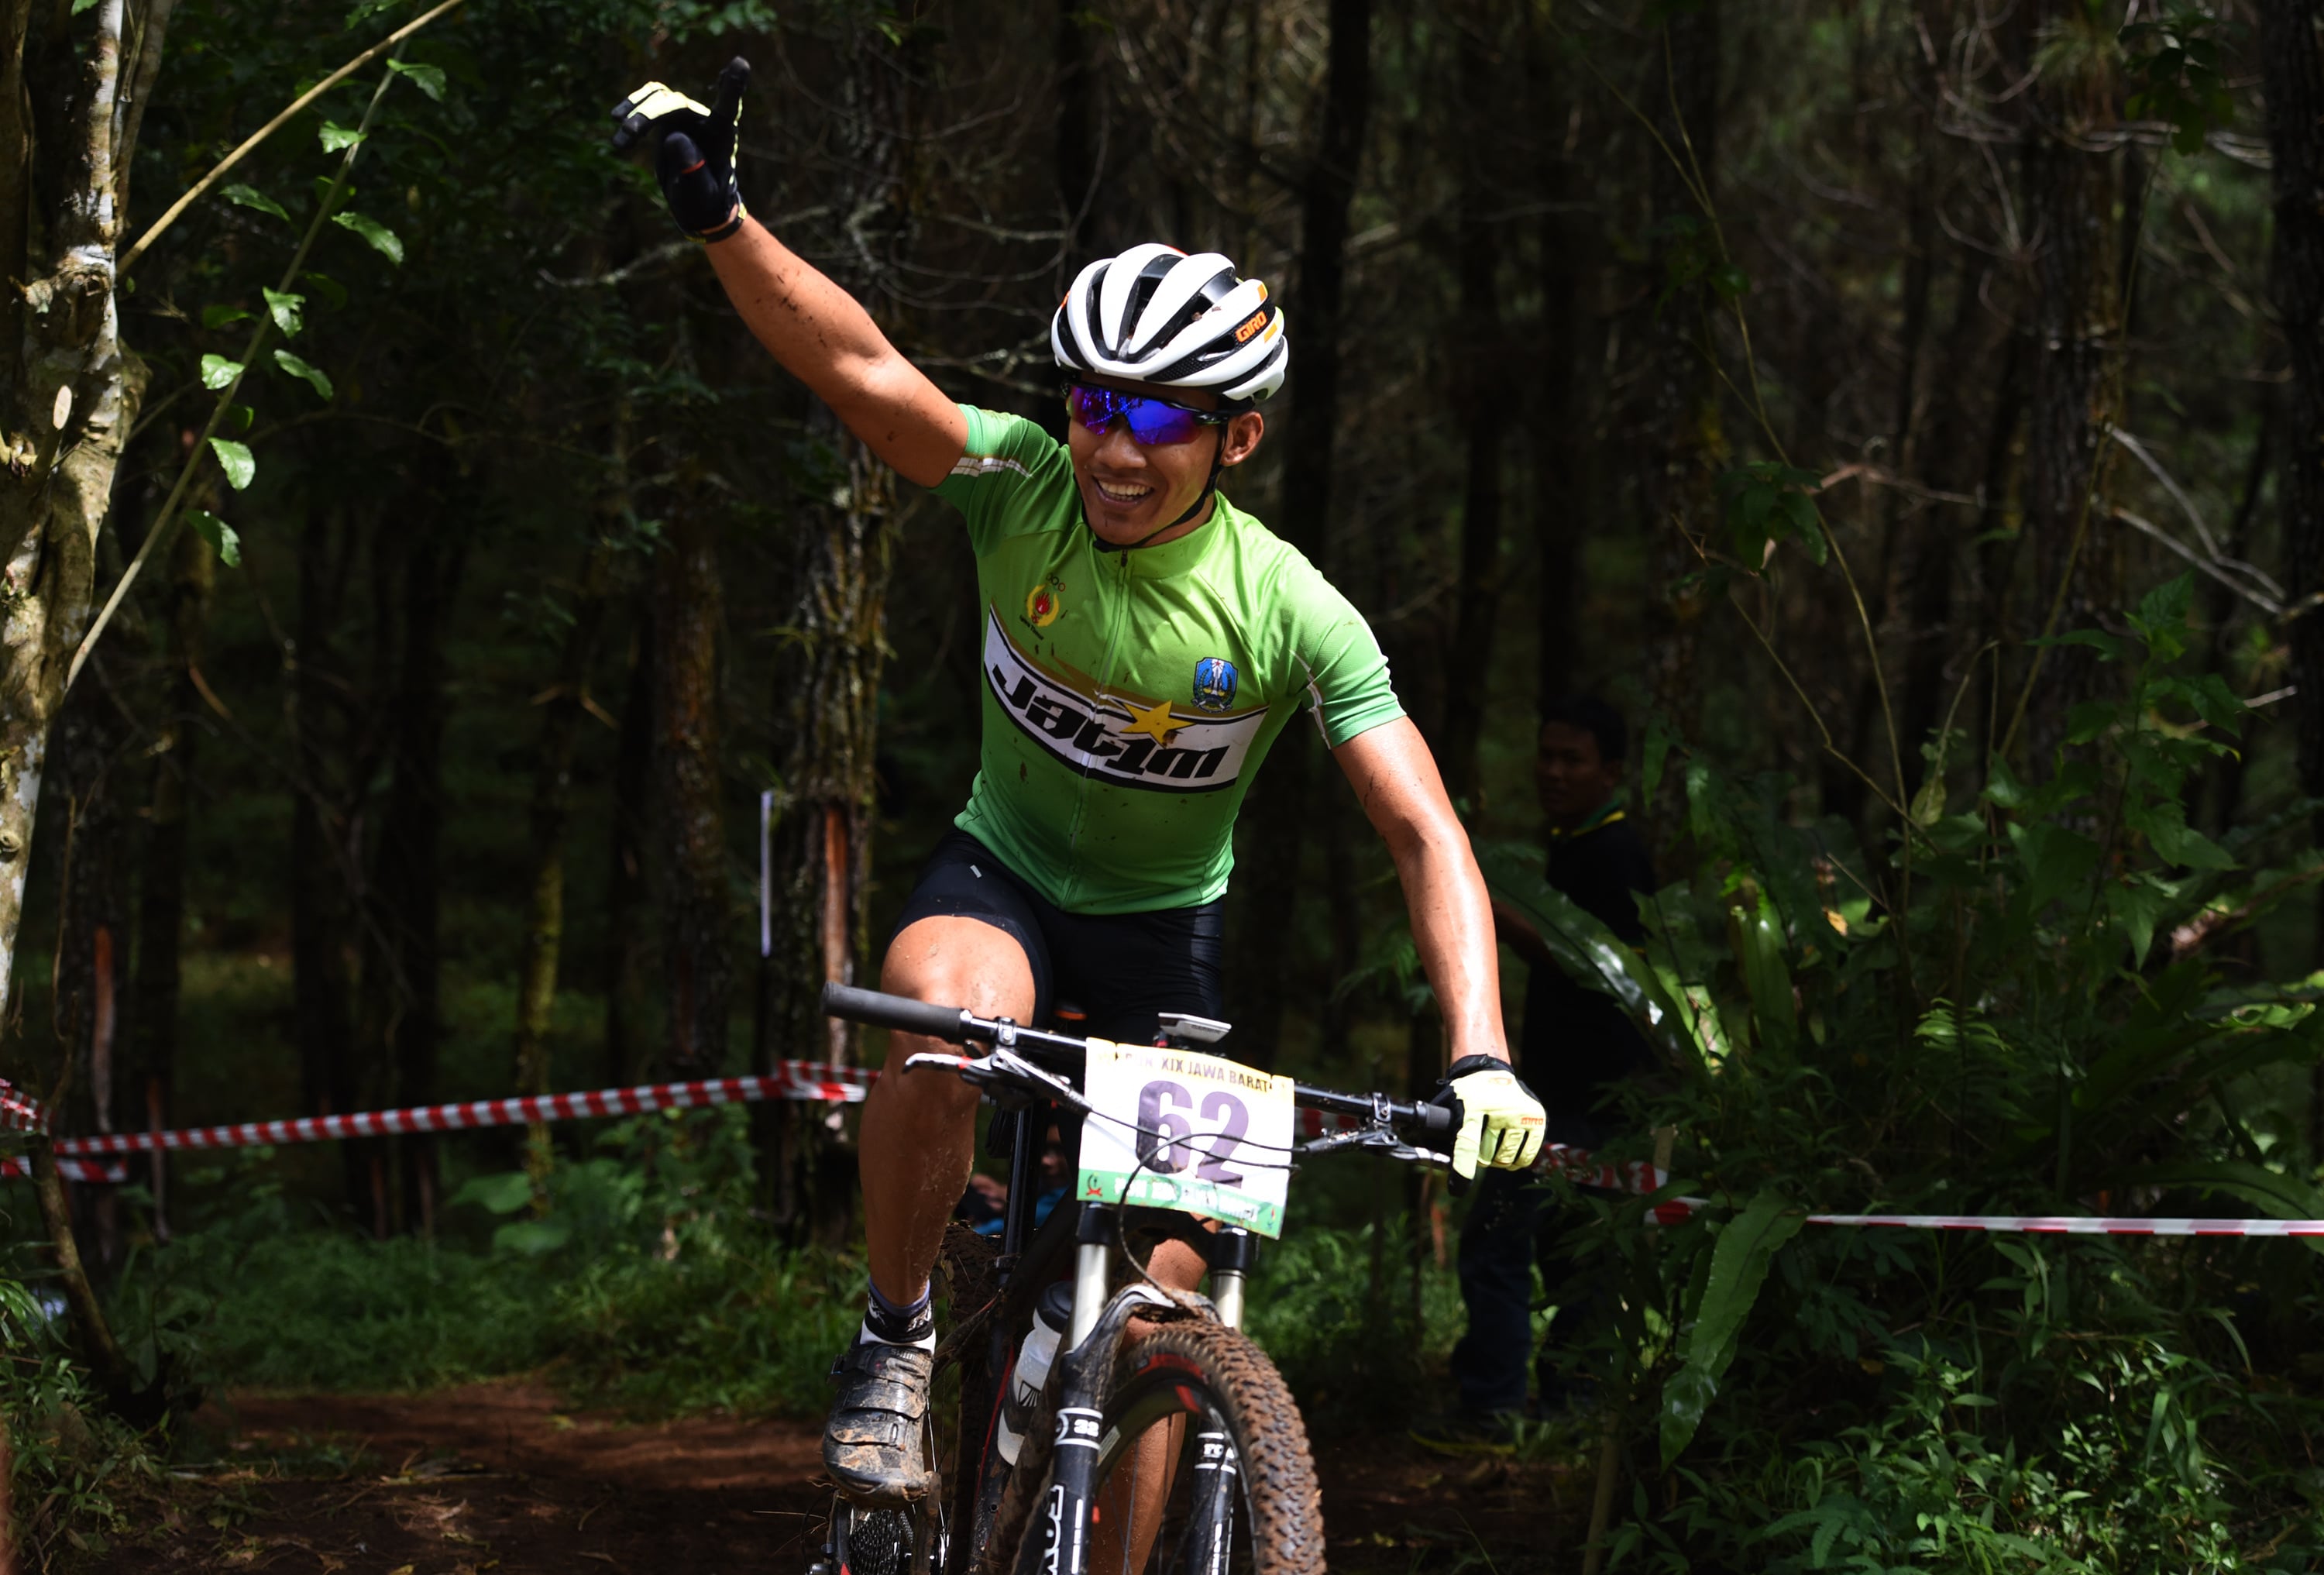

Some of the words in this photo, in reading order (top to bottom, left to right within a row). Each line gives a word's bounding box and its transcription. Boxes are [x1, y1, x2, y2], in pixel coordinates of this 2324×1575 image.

[1235, 311, 1267, 342] GIRO
[992, 664, 1231, 779] Jatim
[1161, 1057, 1184, 1073] XIX
[1188, 1061, 1225, 1082] JAWA
[1229, 1070, 1268, 1093] BARAT
[1136, 1080, 1249, 1188] 62
[1074, 1419, 1099, 1437] 32
